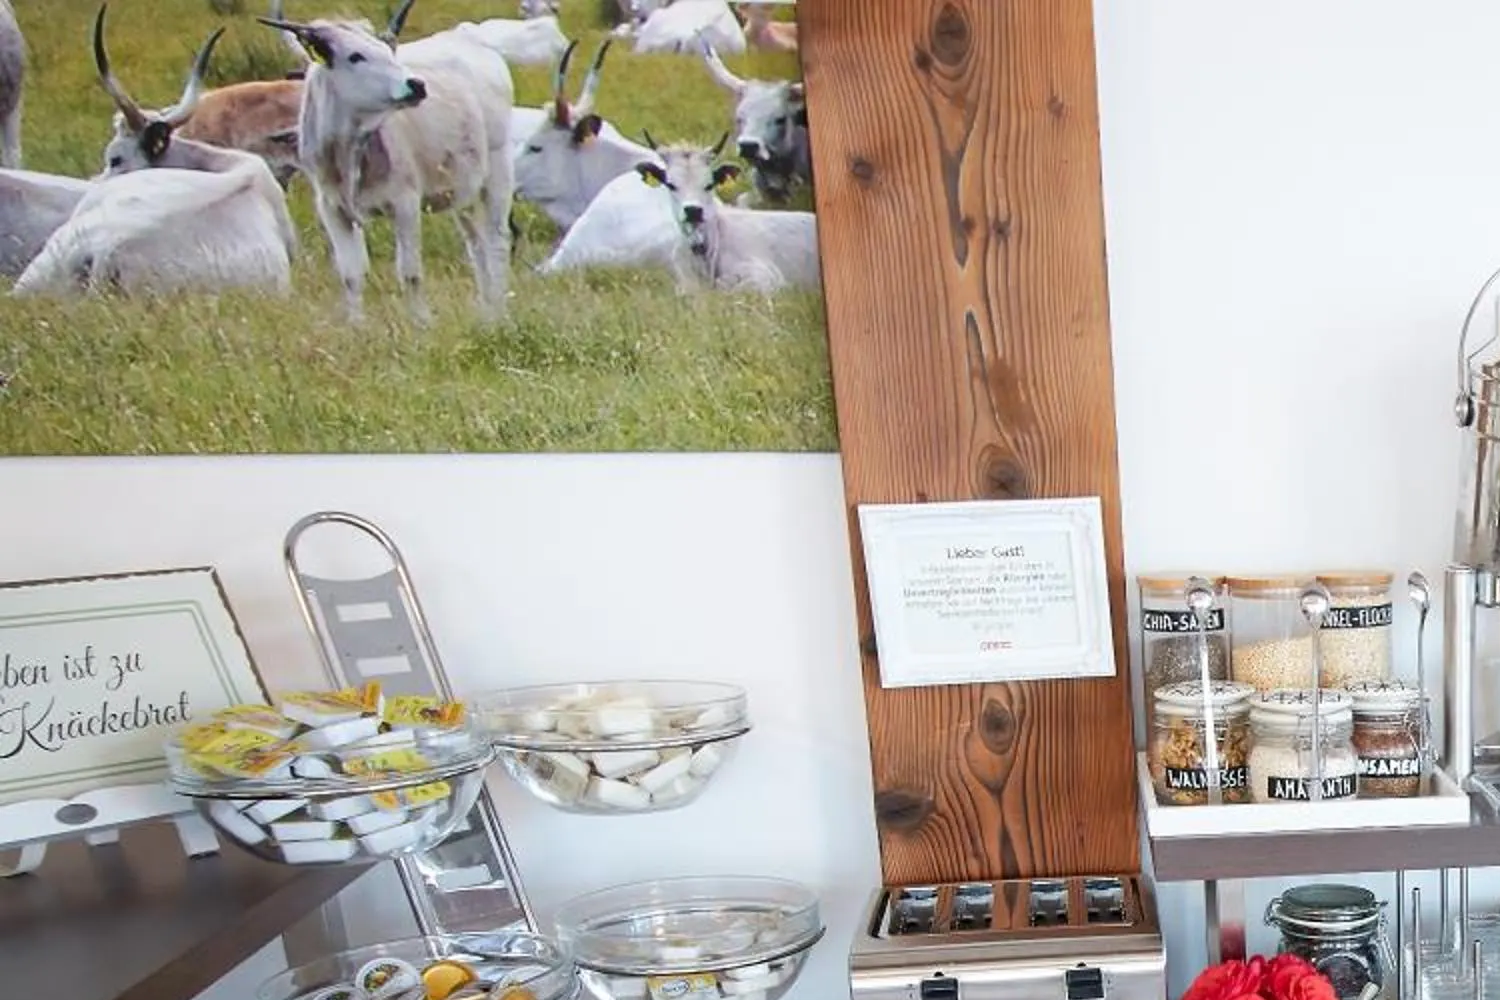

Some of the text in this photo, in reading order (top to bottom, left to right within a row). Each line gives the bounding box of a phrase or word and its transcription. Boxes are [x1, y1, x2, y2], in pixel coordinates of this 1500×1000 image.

[1144, 611, 1220, 631] CHIA-SAEN
[0, 645, 144, 691] ben ist zu
[0, 690, 193, 759] Knäckebrot
[1358, 758, 1420, 776] NSAMEN
[1274, 777, 1351, 799] AMAANTH
